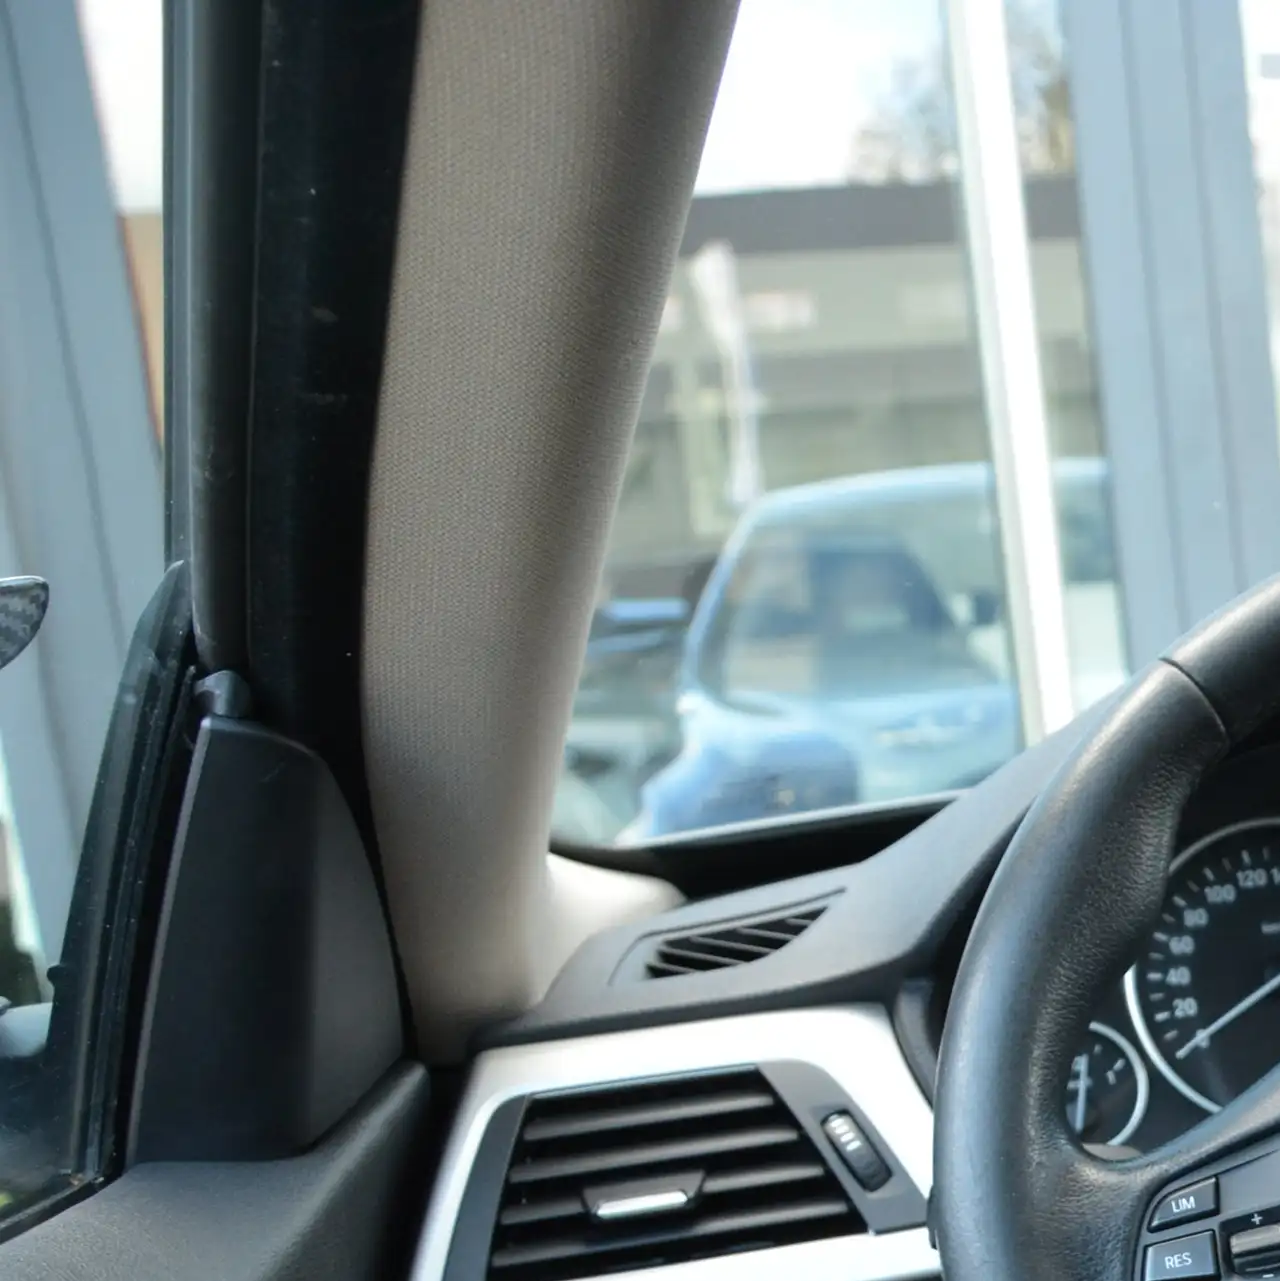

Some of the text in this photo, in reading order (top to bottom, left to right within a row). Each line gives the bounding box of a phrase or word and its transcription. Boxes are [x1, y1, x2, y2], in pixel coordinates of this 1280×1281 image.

[1236, 869, 1268, 889] 120
[1204, 883, 1237, 904] 100
[1183, 907, 1209, 927] 80
[1168, 935, 1196, 955] 60
[1165, 966, 1192, 986] 40
[1172, 997, 1199, 1018] 20
[1171, 1196, 1195, 1213] LIM
[1164, 1252, 1193, 1269] RES
